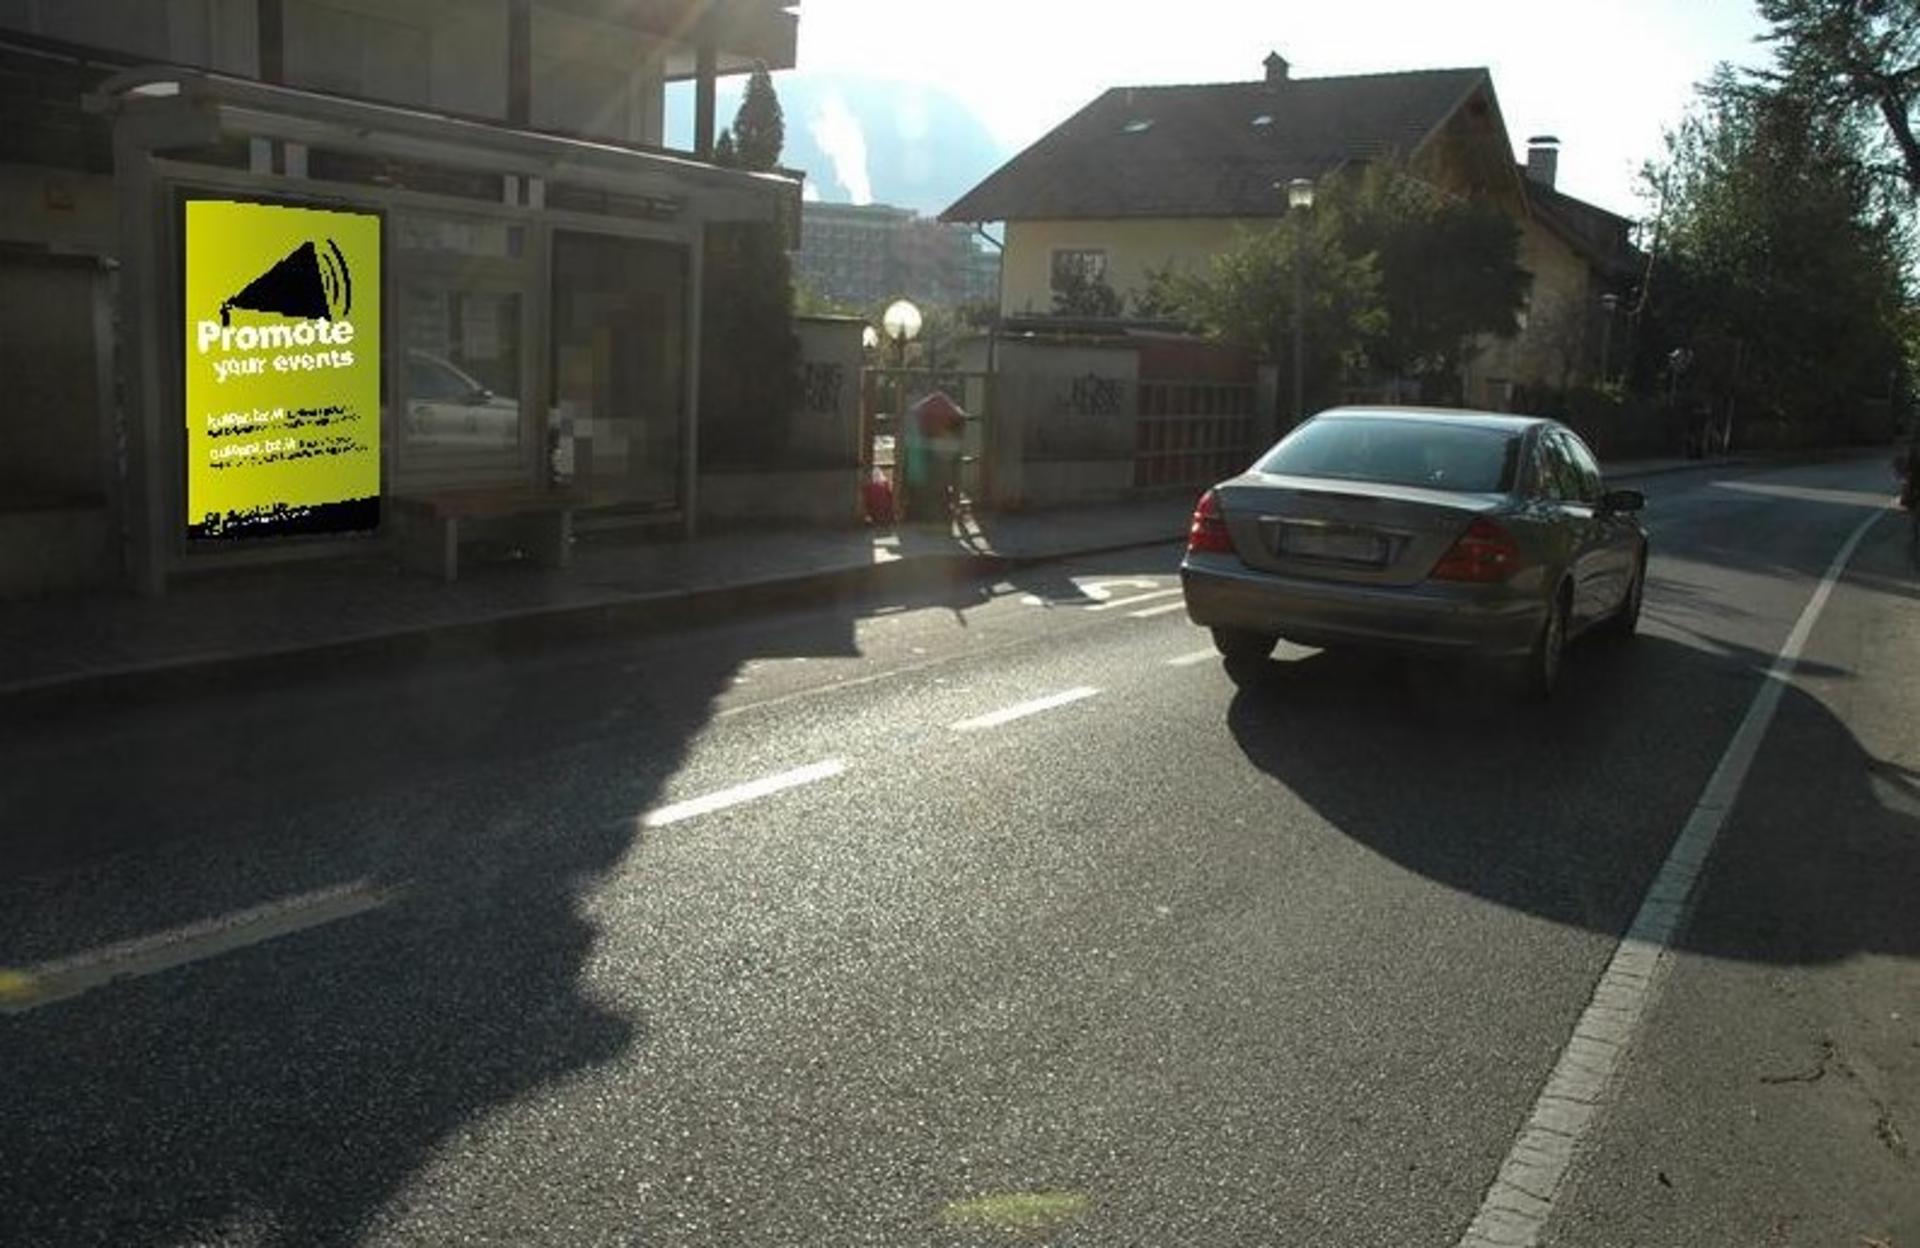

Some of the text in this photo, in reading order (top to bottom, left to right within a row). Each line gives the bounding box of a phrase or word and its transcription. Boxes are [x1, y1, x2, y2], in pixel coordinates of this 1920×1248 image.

[198, 316, 354, 354] Promote
[213, 350, 354, 383] your events
